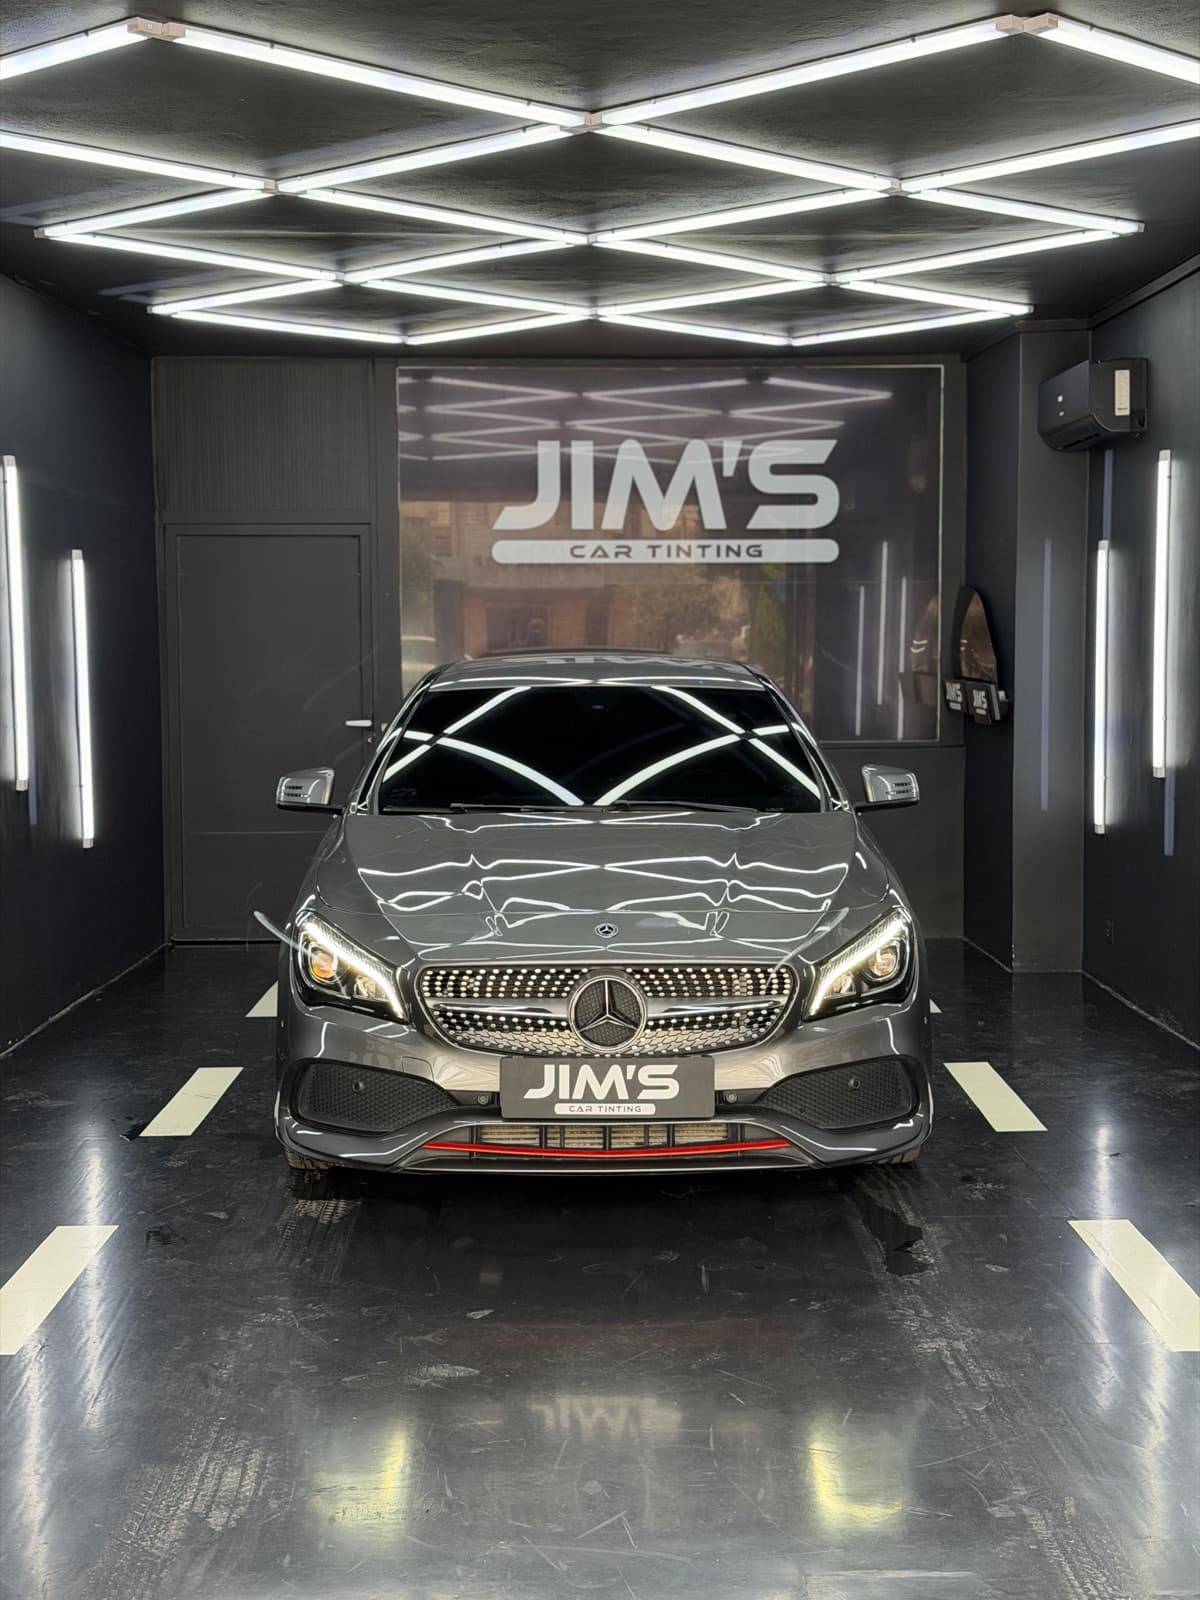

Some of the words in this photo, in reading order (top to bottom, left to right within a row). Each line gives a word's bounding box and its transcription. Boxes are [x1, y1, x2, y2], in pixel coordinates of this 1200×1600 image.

[493, 438, 840, 530] JIM'S
[570, 544, 632, 559] CAR
[647, 544, 763, 559] TINTING
[523, 1064, 680, 1100] JIM'S
[568, 1105, 593, 1113] CAR
[597, 1105, 642, 1113] TINTING
